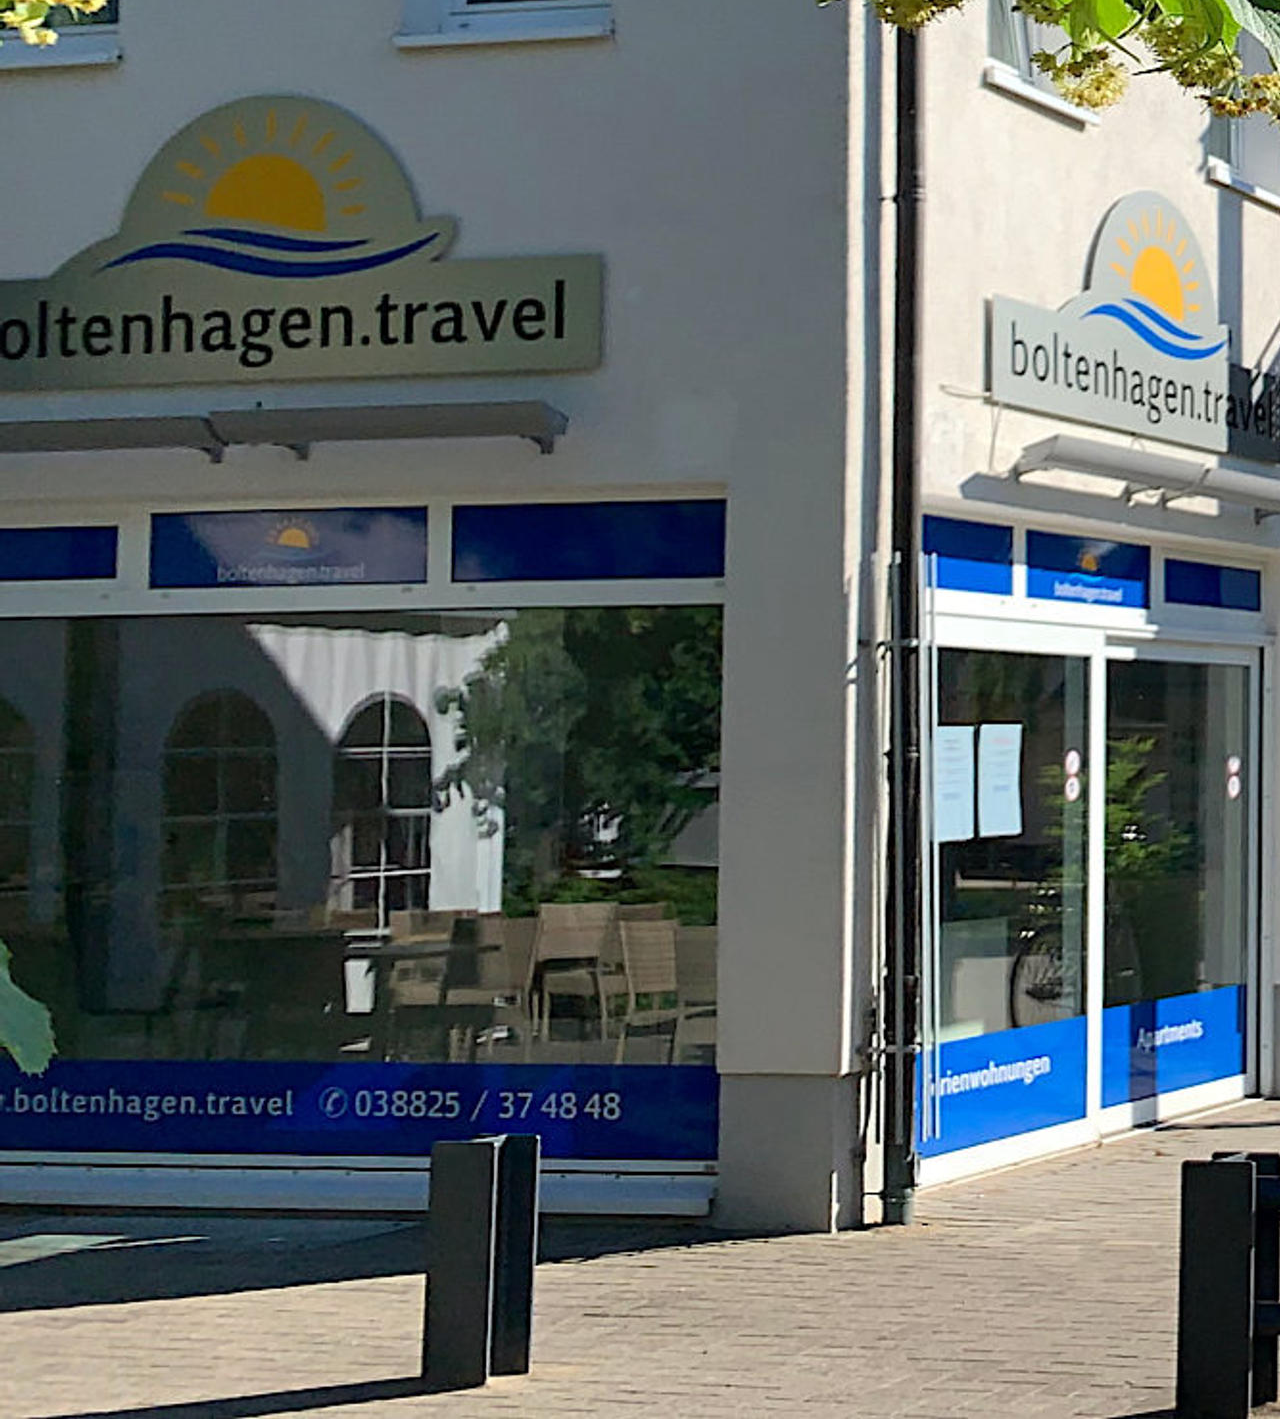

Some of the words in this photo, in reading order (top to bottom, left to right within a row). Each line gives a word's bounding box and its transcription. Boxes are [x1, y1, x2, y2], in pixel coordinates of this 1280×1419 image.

[1011, 320, 1274, 438] boltenhagen.travel
[354, 1090, 461, 1118] 038825
[470, 1089, 489, 1122] /
[498, 1092, 533, 1119] 37
[540, 1092, 577, 1119] 48
[583, 1092, 621, 1120] 48
